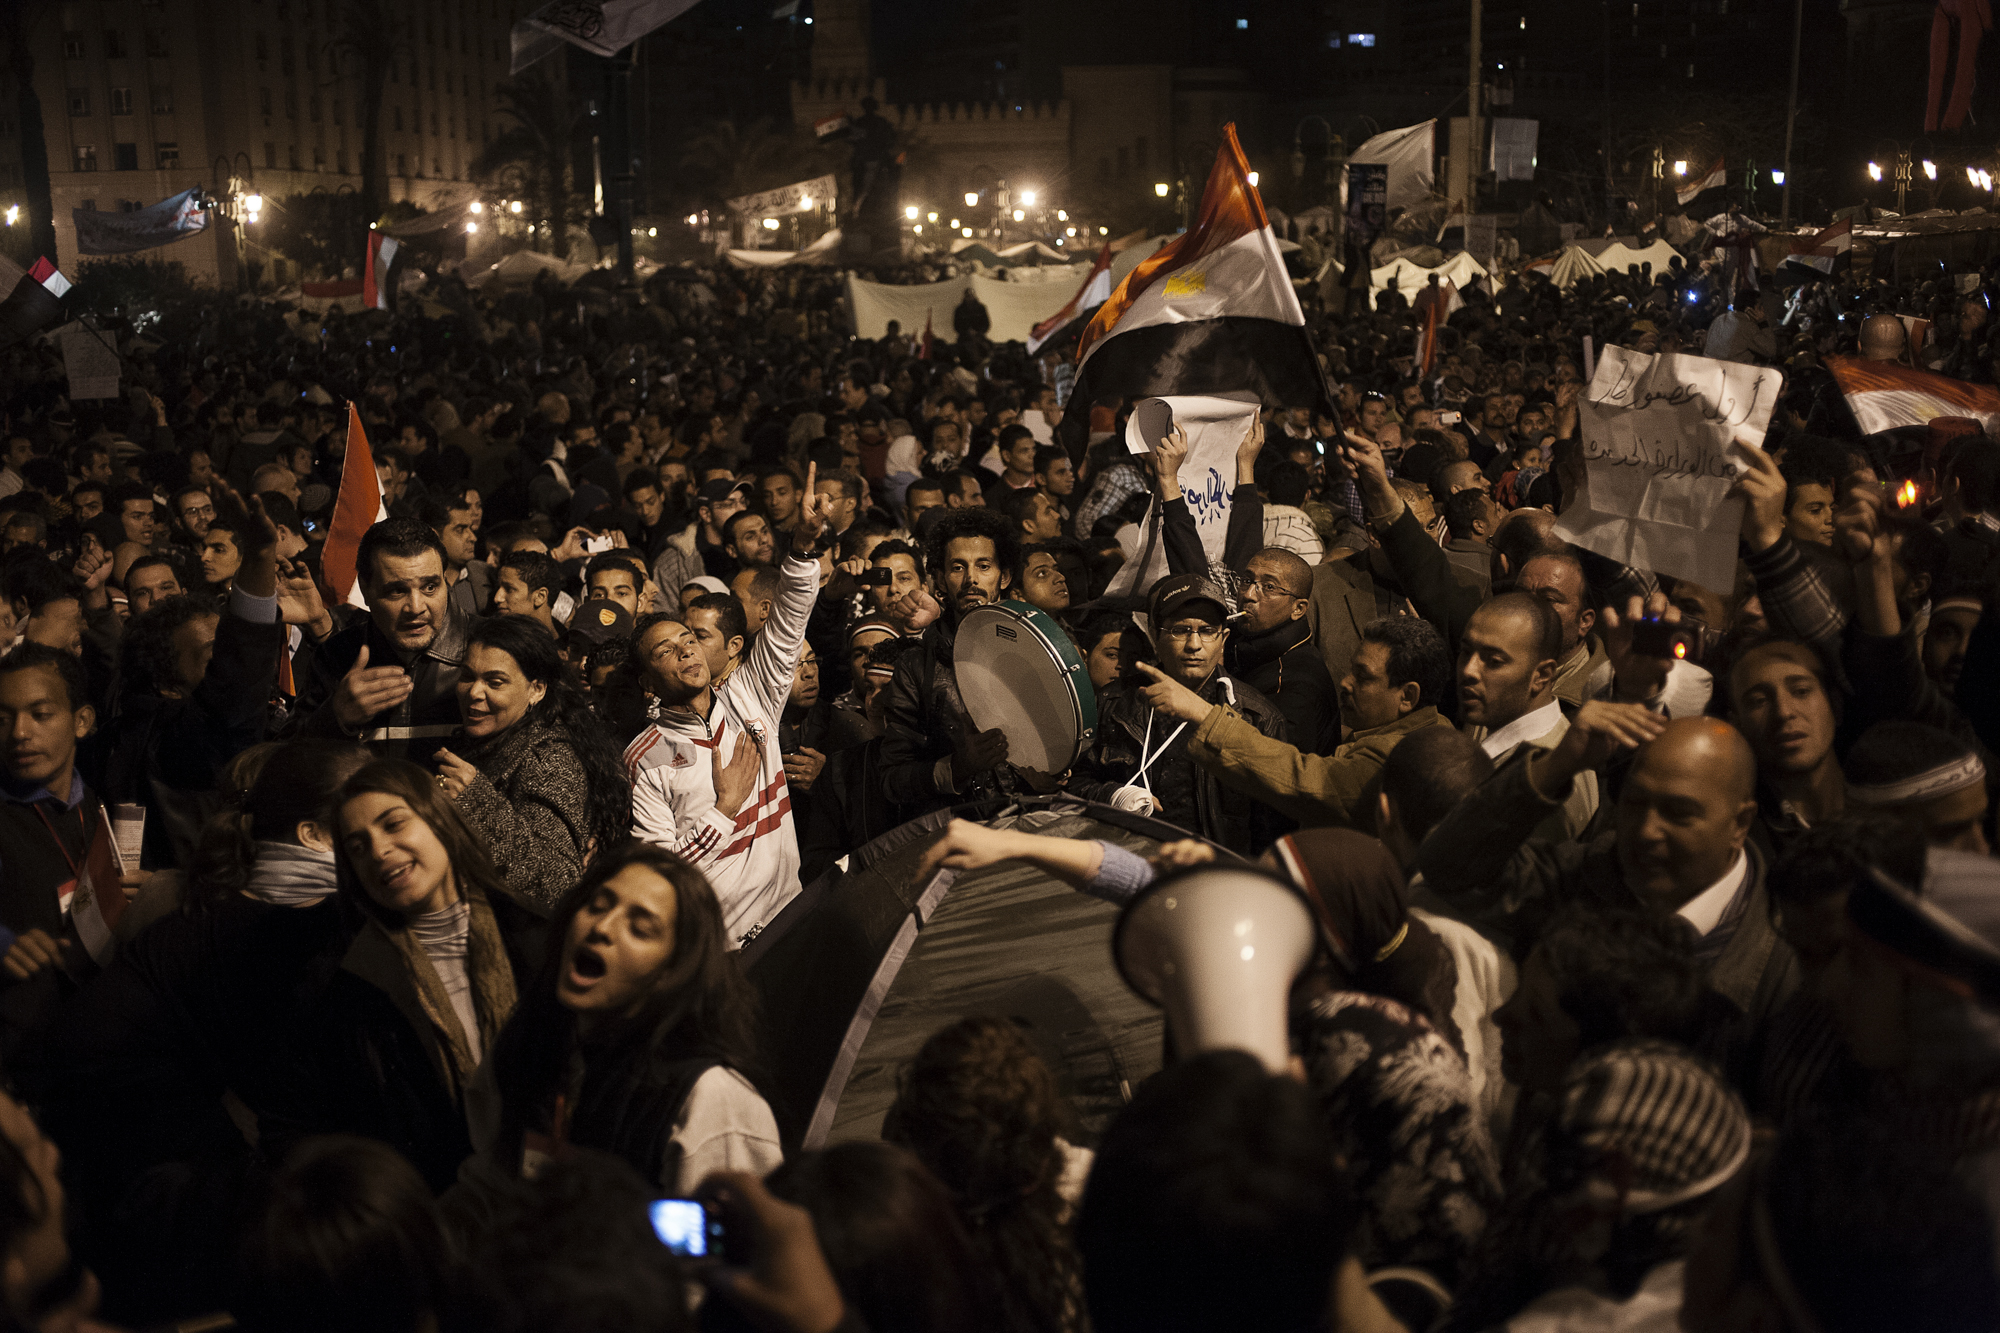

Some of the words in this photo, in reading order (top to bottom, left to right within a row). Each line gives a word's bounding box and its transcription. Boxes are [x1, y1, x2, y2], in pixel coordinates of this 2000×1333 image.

[1620, 383, 1702, 410] عصفور
[1703, 369, 1766, 426] أول
[1709, 454, 1738, 478] من
